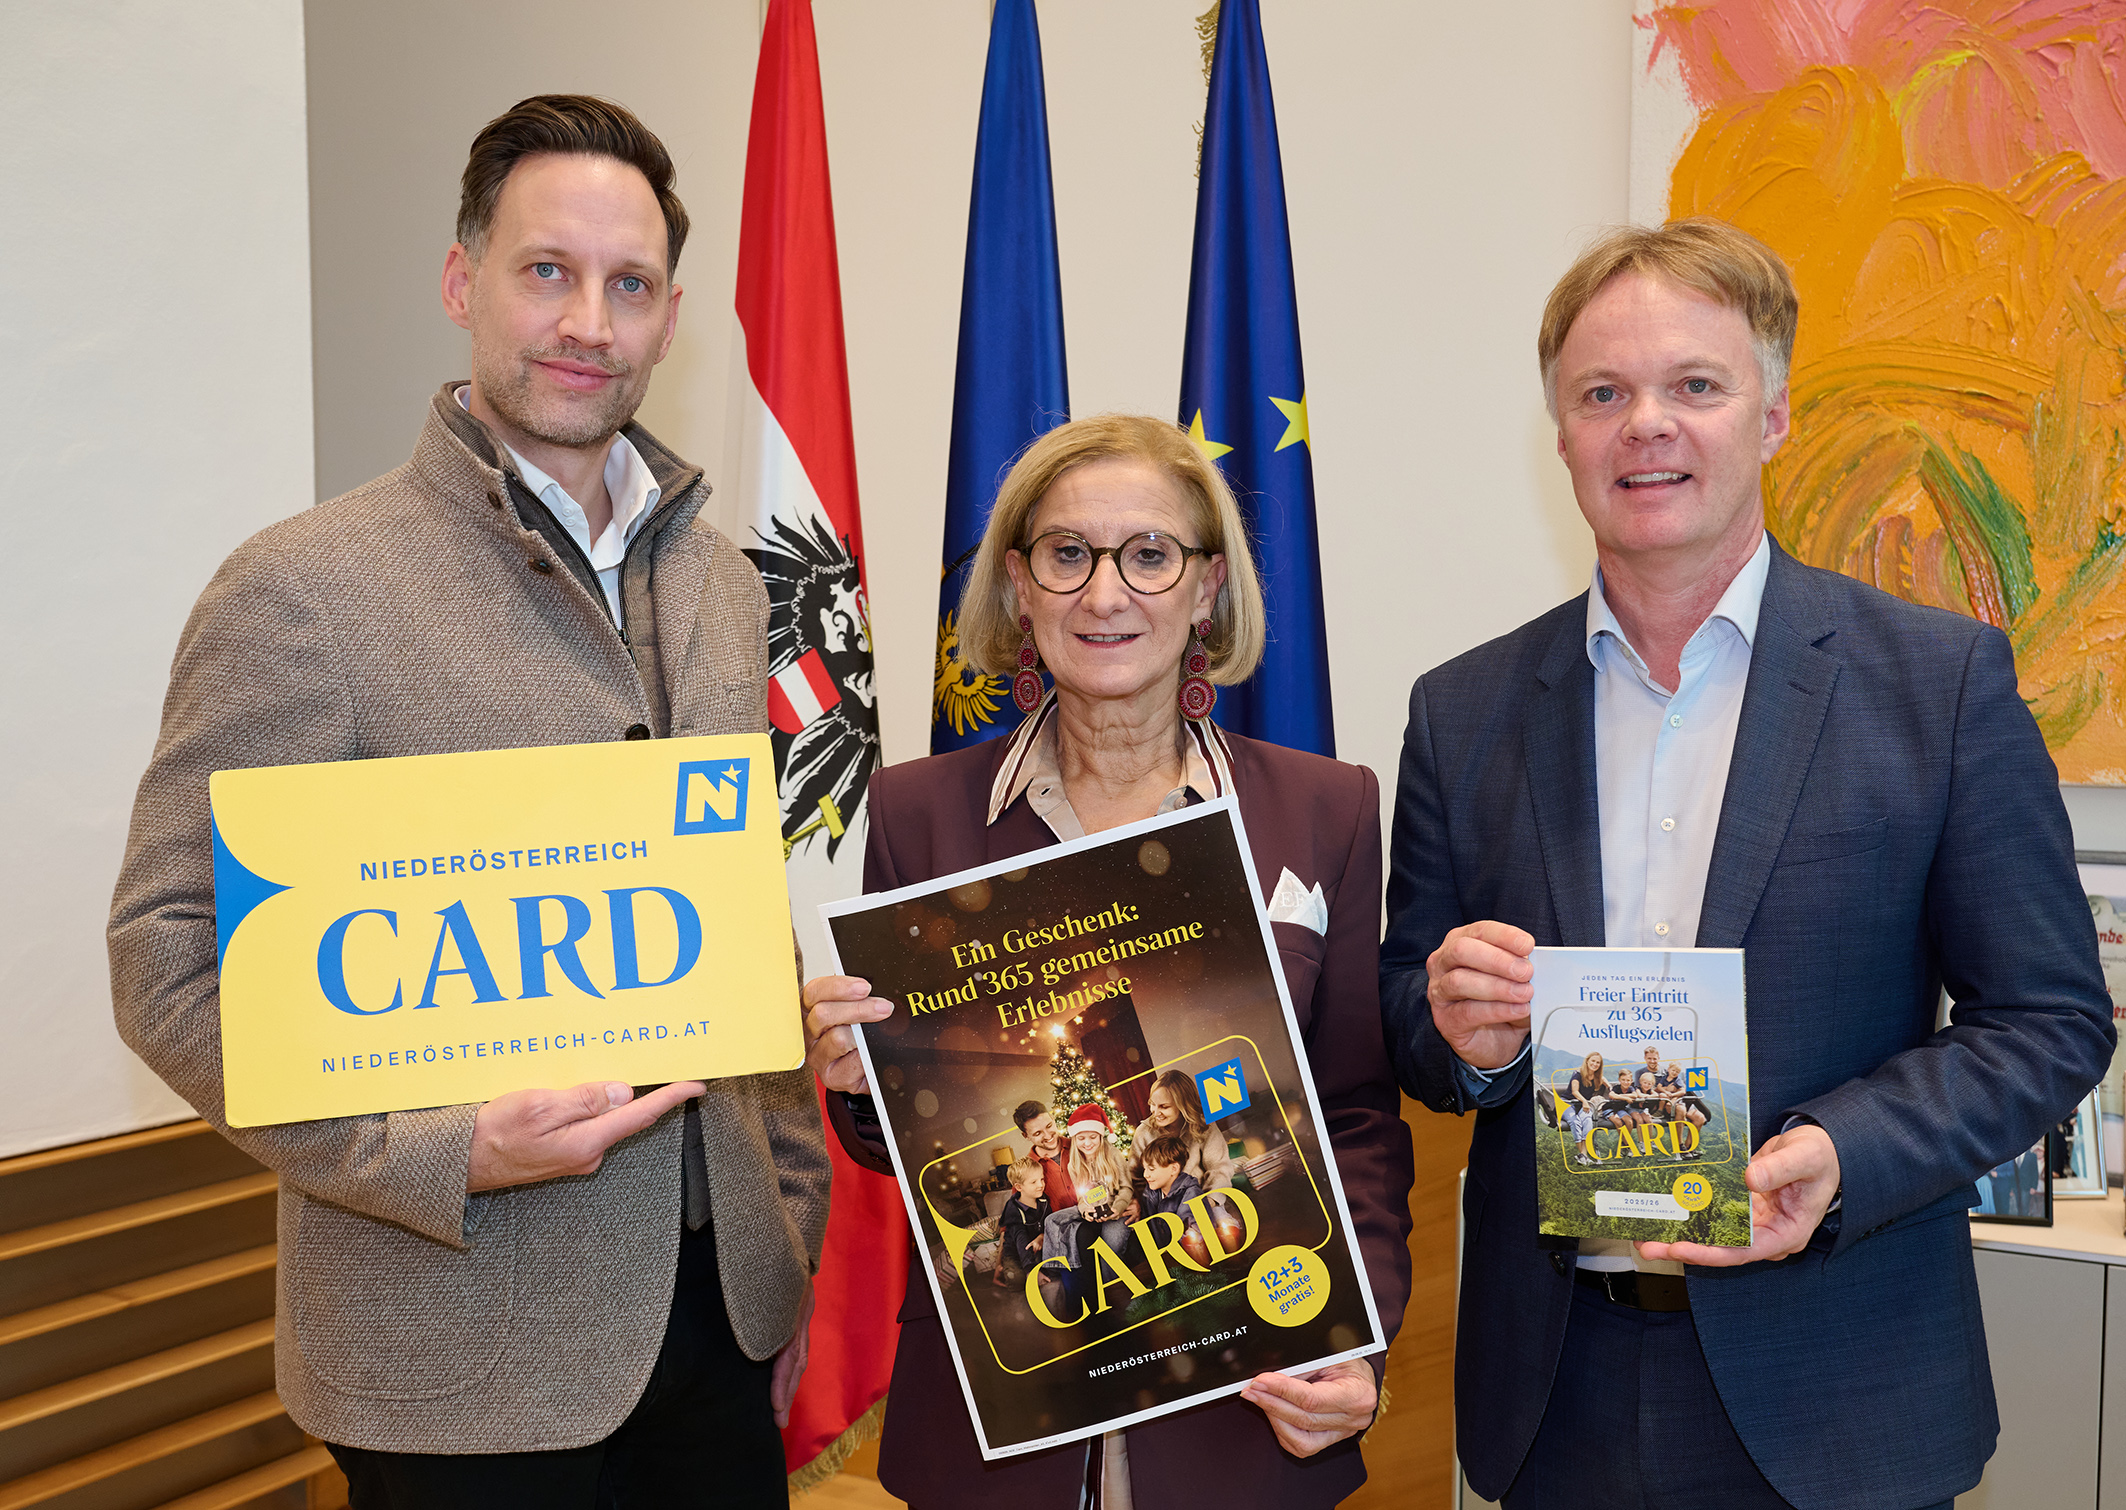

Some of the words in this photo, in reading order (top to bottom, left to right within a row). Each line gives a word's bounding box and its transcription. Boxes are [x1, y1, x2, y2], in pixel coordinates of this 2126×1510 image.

[360, 840, 649, 881] NIEDERÖSTERREICH
[316, 886, 703, 1016] CARD
[951, 939, 998, 970] Ein
[1002, 900, 1141, 954] Geschenk:
[906, 975, 978, 1018] Rund
[981, 960, 1034, 997] 365
[1040, 919, 1206, 987] gemeinsame
[996, 973, 1134, 1029] Erlebnisse
[1579, 986, 1626, 1002] Freier
[1631, 987, 1689, 1004] Eintritt
[1606, 1009, 1626, 1021] zu
[1631, 1006, 1662, 1022] 365
[322, 1020, 711, 1073] NIEDERÖSTERREICH-CARD.AT
[1578, 1023, 1694, 1044] Ausflugszielen
[1585, 1120, 1700, 1161] CARD
[1624, 1198, 1660, 1206] 2025/26
[1682, 1181, 1703, 1195] 20
[1024, 1187, 1260, 1329] CARD
[1258, 1255, 1305, 1292] 12+3
[1267, 1272, 1312, 1304] Monate
[1277, 1284, 1317, 1317] gratis!
[1088, 1325, 1249, 1379] NIEDERÖSTERREICH-CARD.AT
